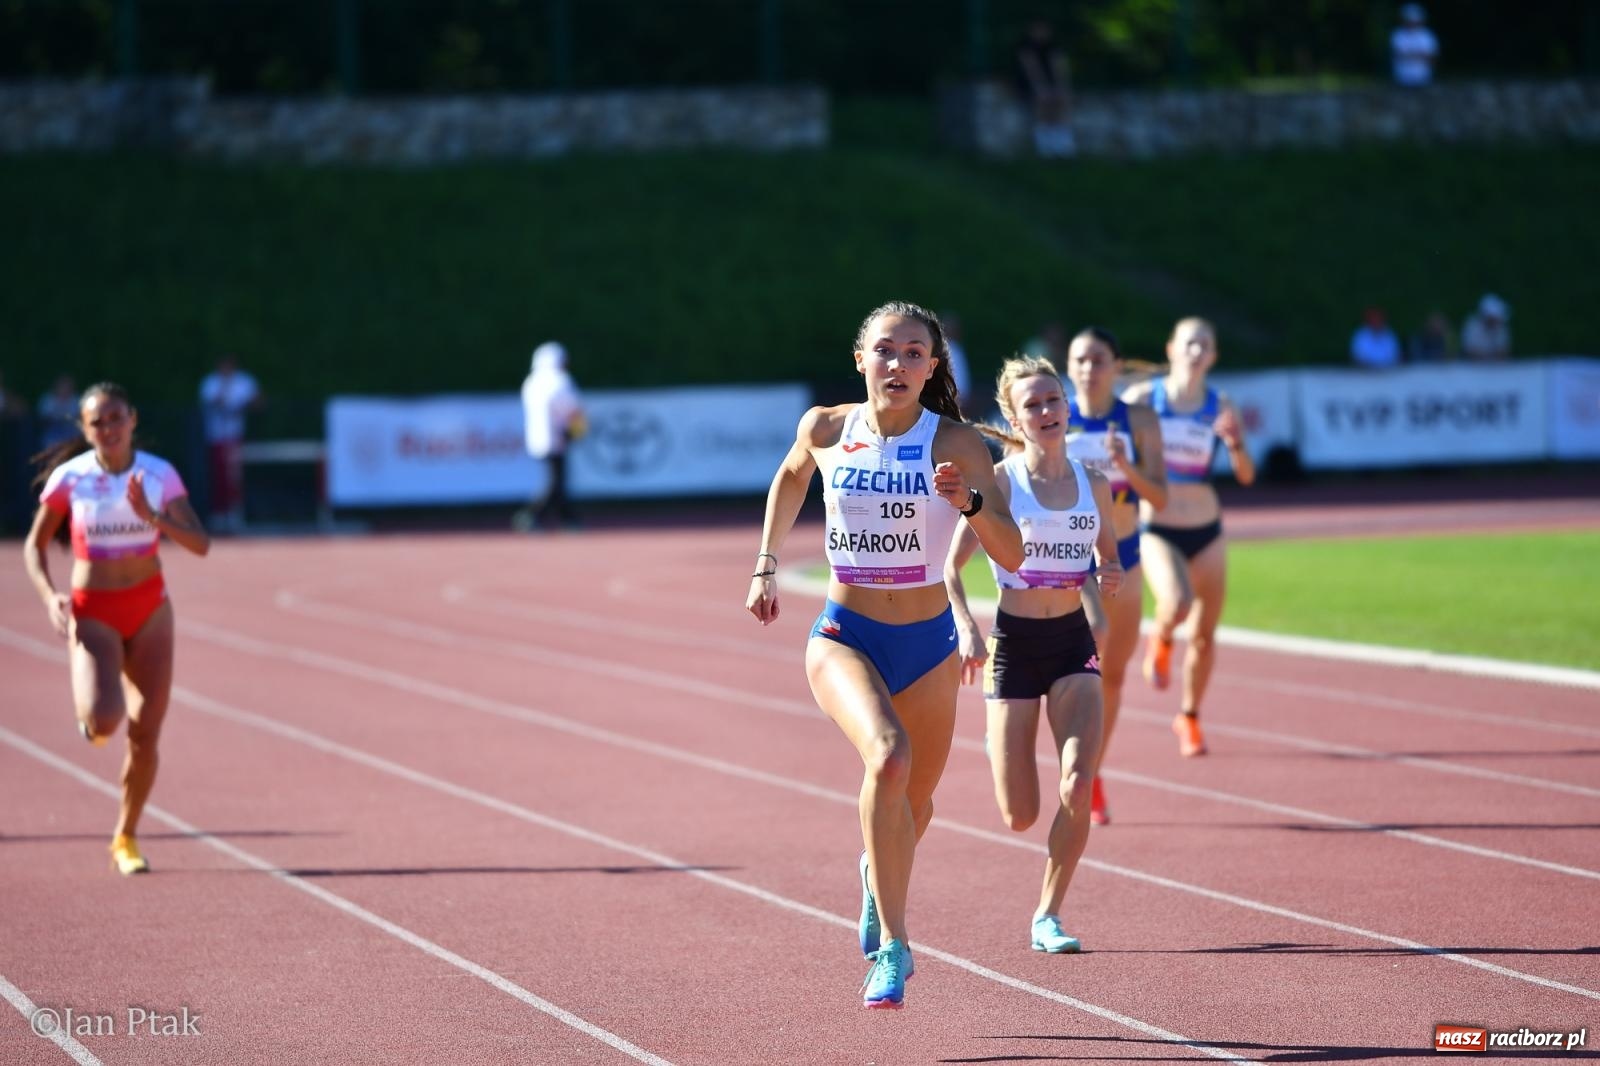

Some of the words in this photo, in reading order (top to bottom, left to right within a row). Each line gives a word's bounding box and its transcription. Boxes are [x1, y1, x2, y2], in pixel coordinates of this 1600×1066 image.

[1324, 399, 1394, 431] TVP
[1405, 393, 1521, 428] SPORT
[832, 467, 929, 495] CZECHIA
[880, 502, 916, 519] 105
[1069, 516, 1095, 530] 305
[829, 528, 921, 553] ŠAFÁROVÁ
